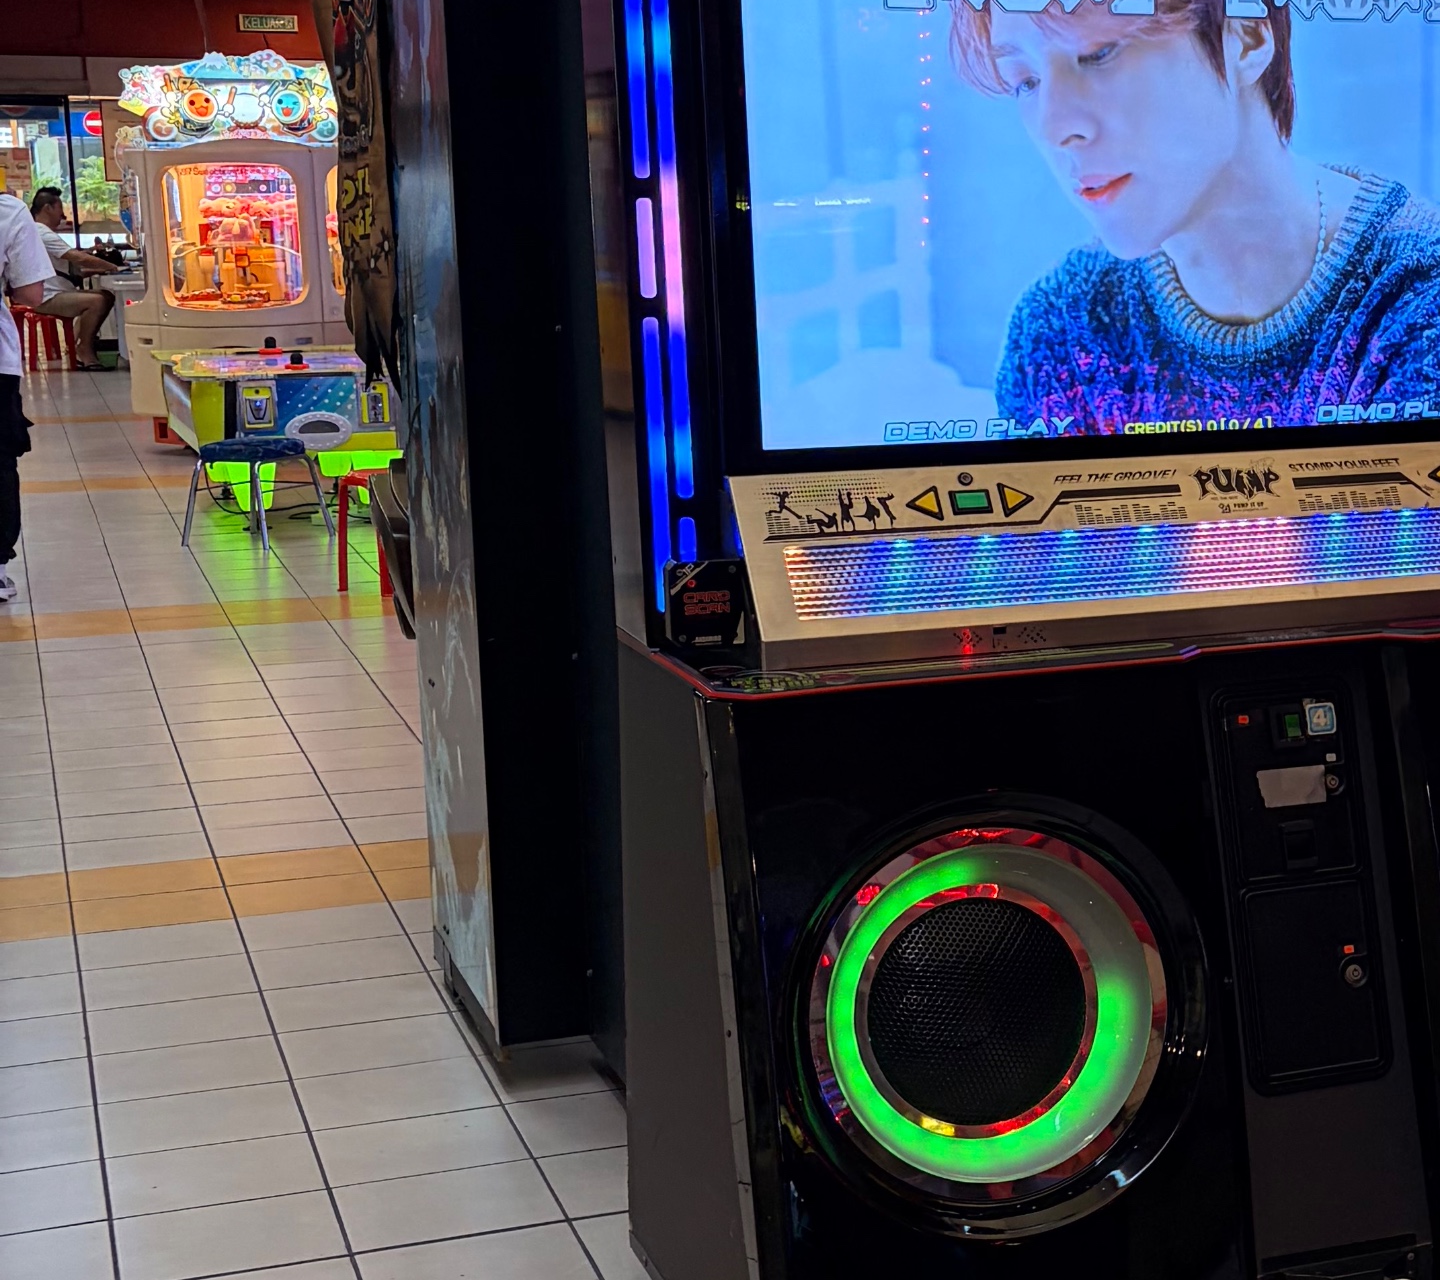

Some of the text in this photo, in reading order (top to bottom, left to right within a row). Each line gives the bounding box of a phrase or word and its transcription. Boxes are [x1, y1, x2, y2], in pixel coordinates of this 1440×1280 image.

[1317, 402, 1397, 423] DEMO
[884, 415, 1076, 442] DEMO PLAY
[1123, 419, 1203, 435] CREDIT(S)
[1288, 461, 1334, 473] STOMP
[1333, 459, 1371, 470] YOUR
[1370, 457, 1400, 469] FEET
[1053, 468, 1177, 485] FEEL THE GROOVE!
[1188, 464, 1281, 501] PUMP
[682, 590, 731, 604] CARD
[684, 601, 731, 616] SCAN
[1312, 707, 1329, 728] 4
